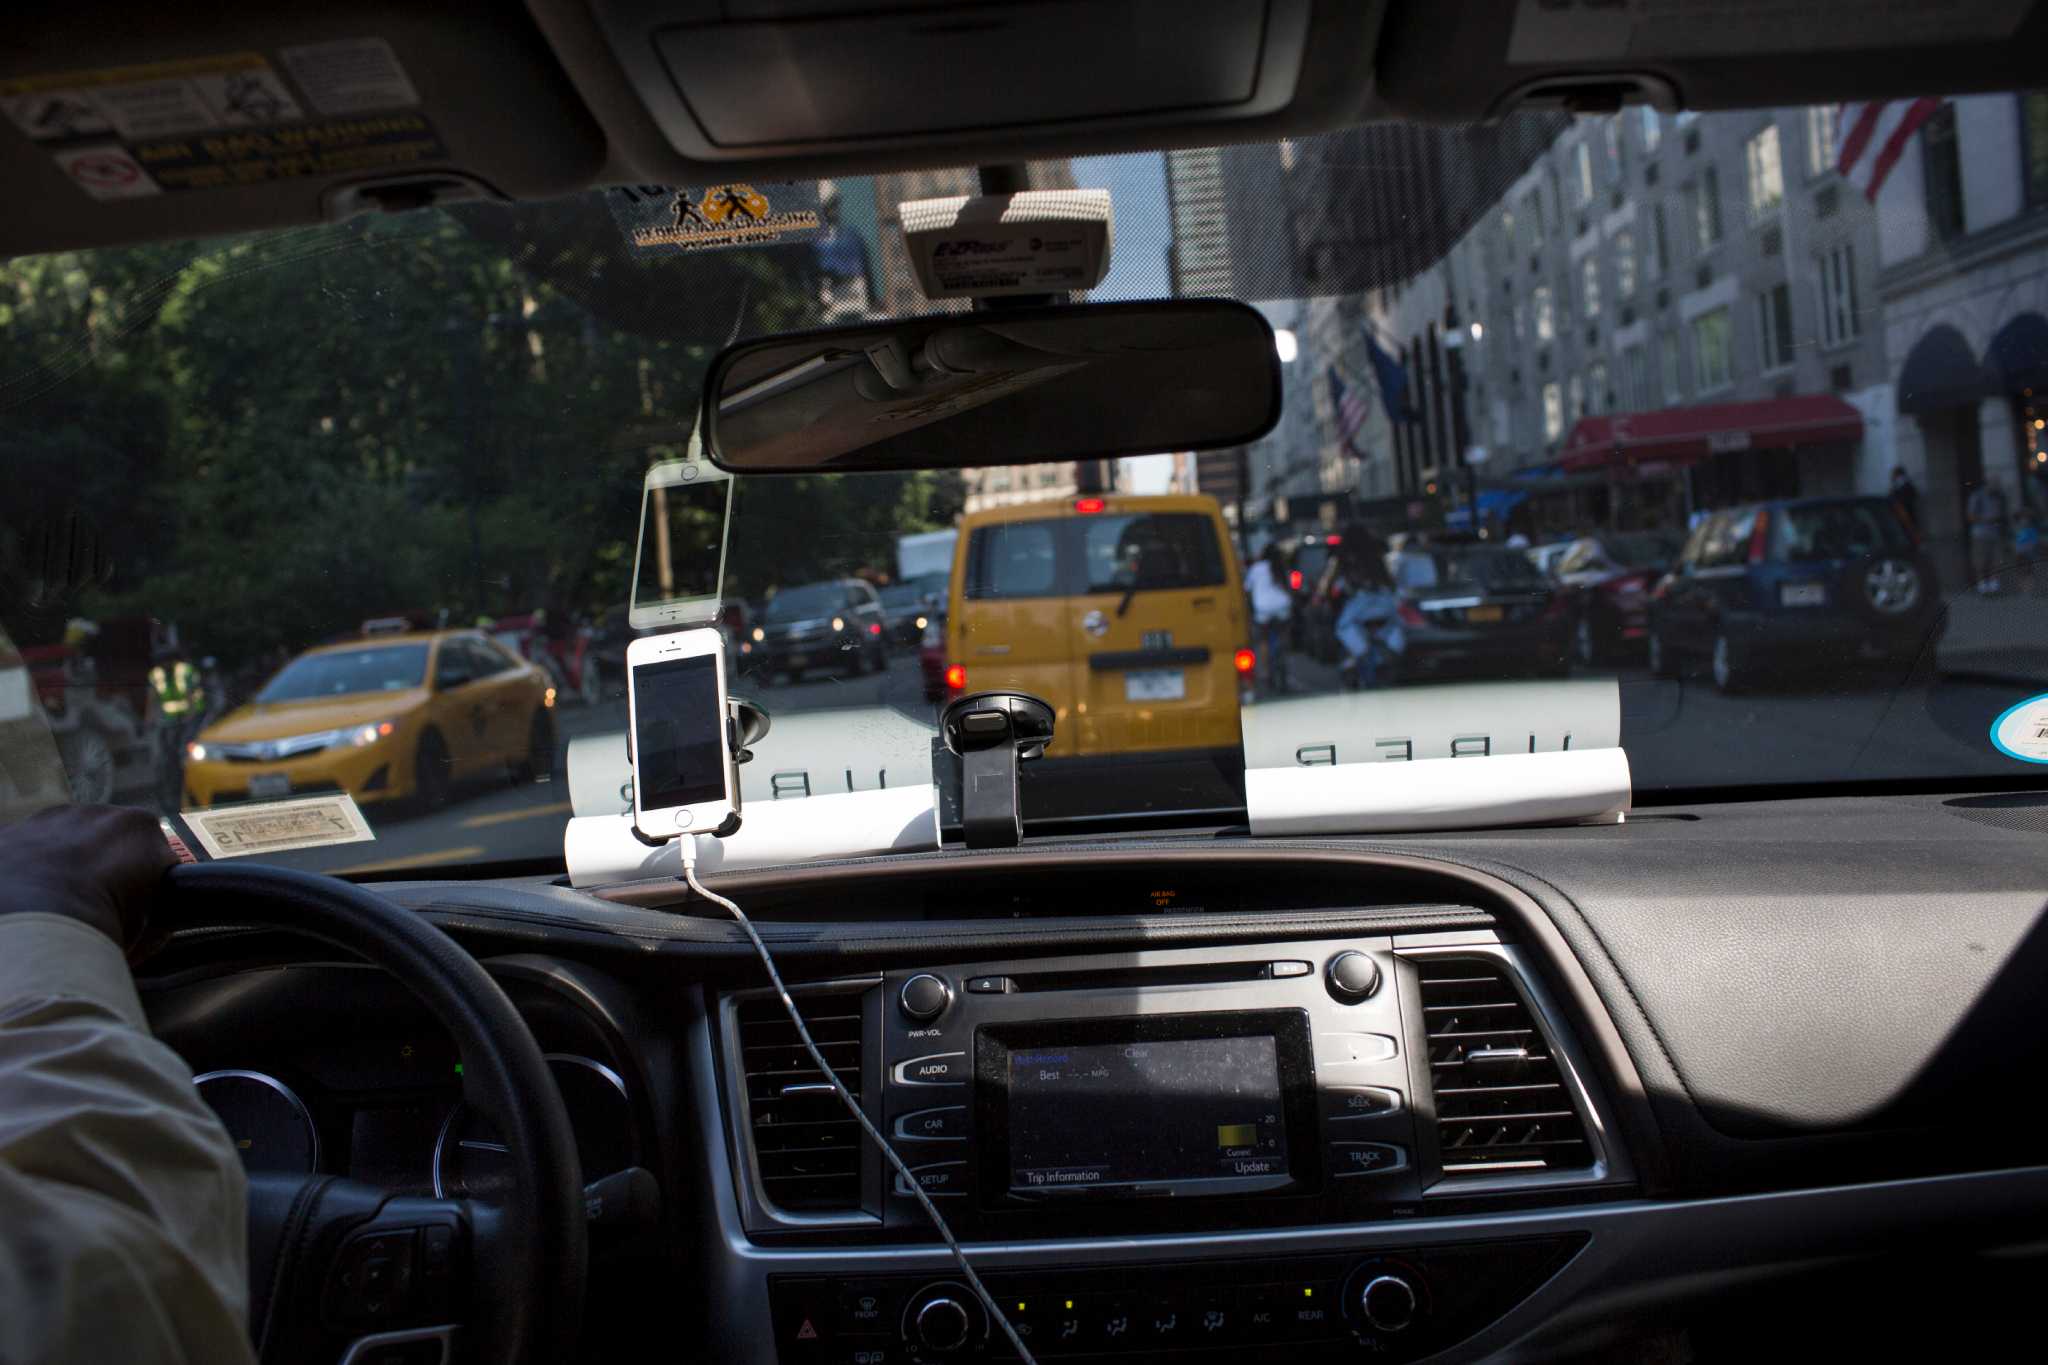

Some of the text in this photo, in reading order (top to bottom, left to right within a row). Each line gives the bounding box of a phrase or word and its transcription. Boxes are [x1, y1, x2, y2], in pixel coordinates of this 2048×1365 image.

[729, 211, 817, 230] CROSSING
[919, 1064, 948, 1075] AUDIO
[1039, 1069, 1060, 1081] Best
[924, 1119, 945, 1129] CAR
[1264, 1114, 1276, 1124] 20
[1349, 1151, 1381, 1162] TRACK
[1234, 1160, 1271, 1175] Update
[919, 1174, 949, 1186] SETUP
[1026, 1170, 1101, 1185] Trip Information
[1252, 1312, 1272, 1324] A/C
[1297, 1310, 1324, 1321] REAR
